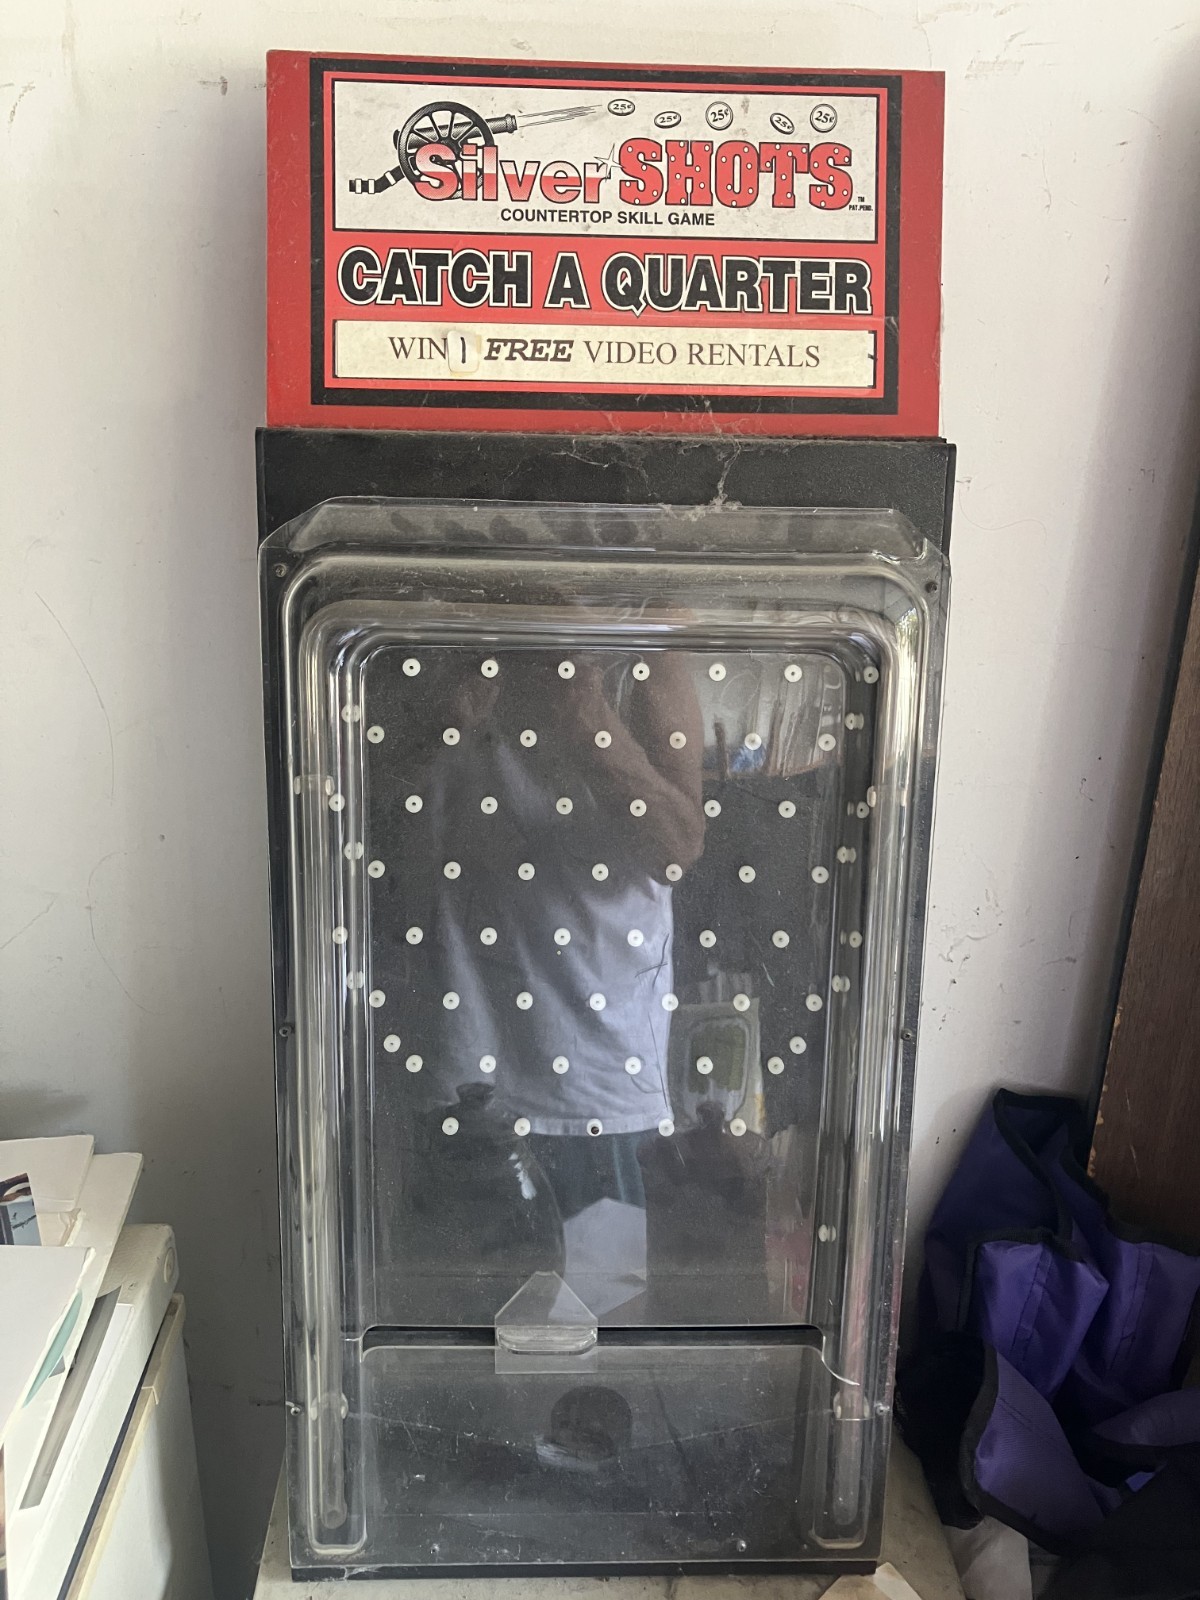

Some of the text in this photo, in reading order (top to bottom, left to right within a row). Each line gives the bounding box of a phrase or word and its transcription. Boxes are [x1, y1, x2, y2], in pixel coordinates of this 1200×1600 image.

[414, 137, 853, 210] Silver SHOTS
[500, 208, 715, 226] COUNTERTOP SKILL GAME
[336, 245, 873, 317] CATCH A QUARTER
[388, 336, 447, 360] WIN
[484, 338, 574, 362] FREE
[583, 340, 677, 365] VIDEO
[687, 342, 821, 368] RENTALS
